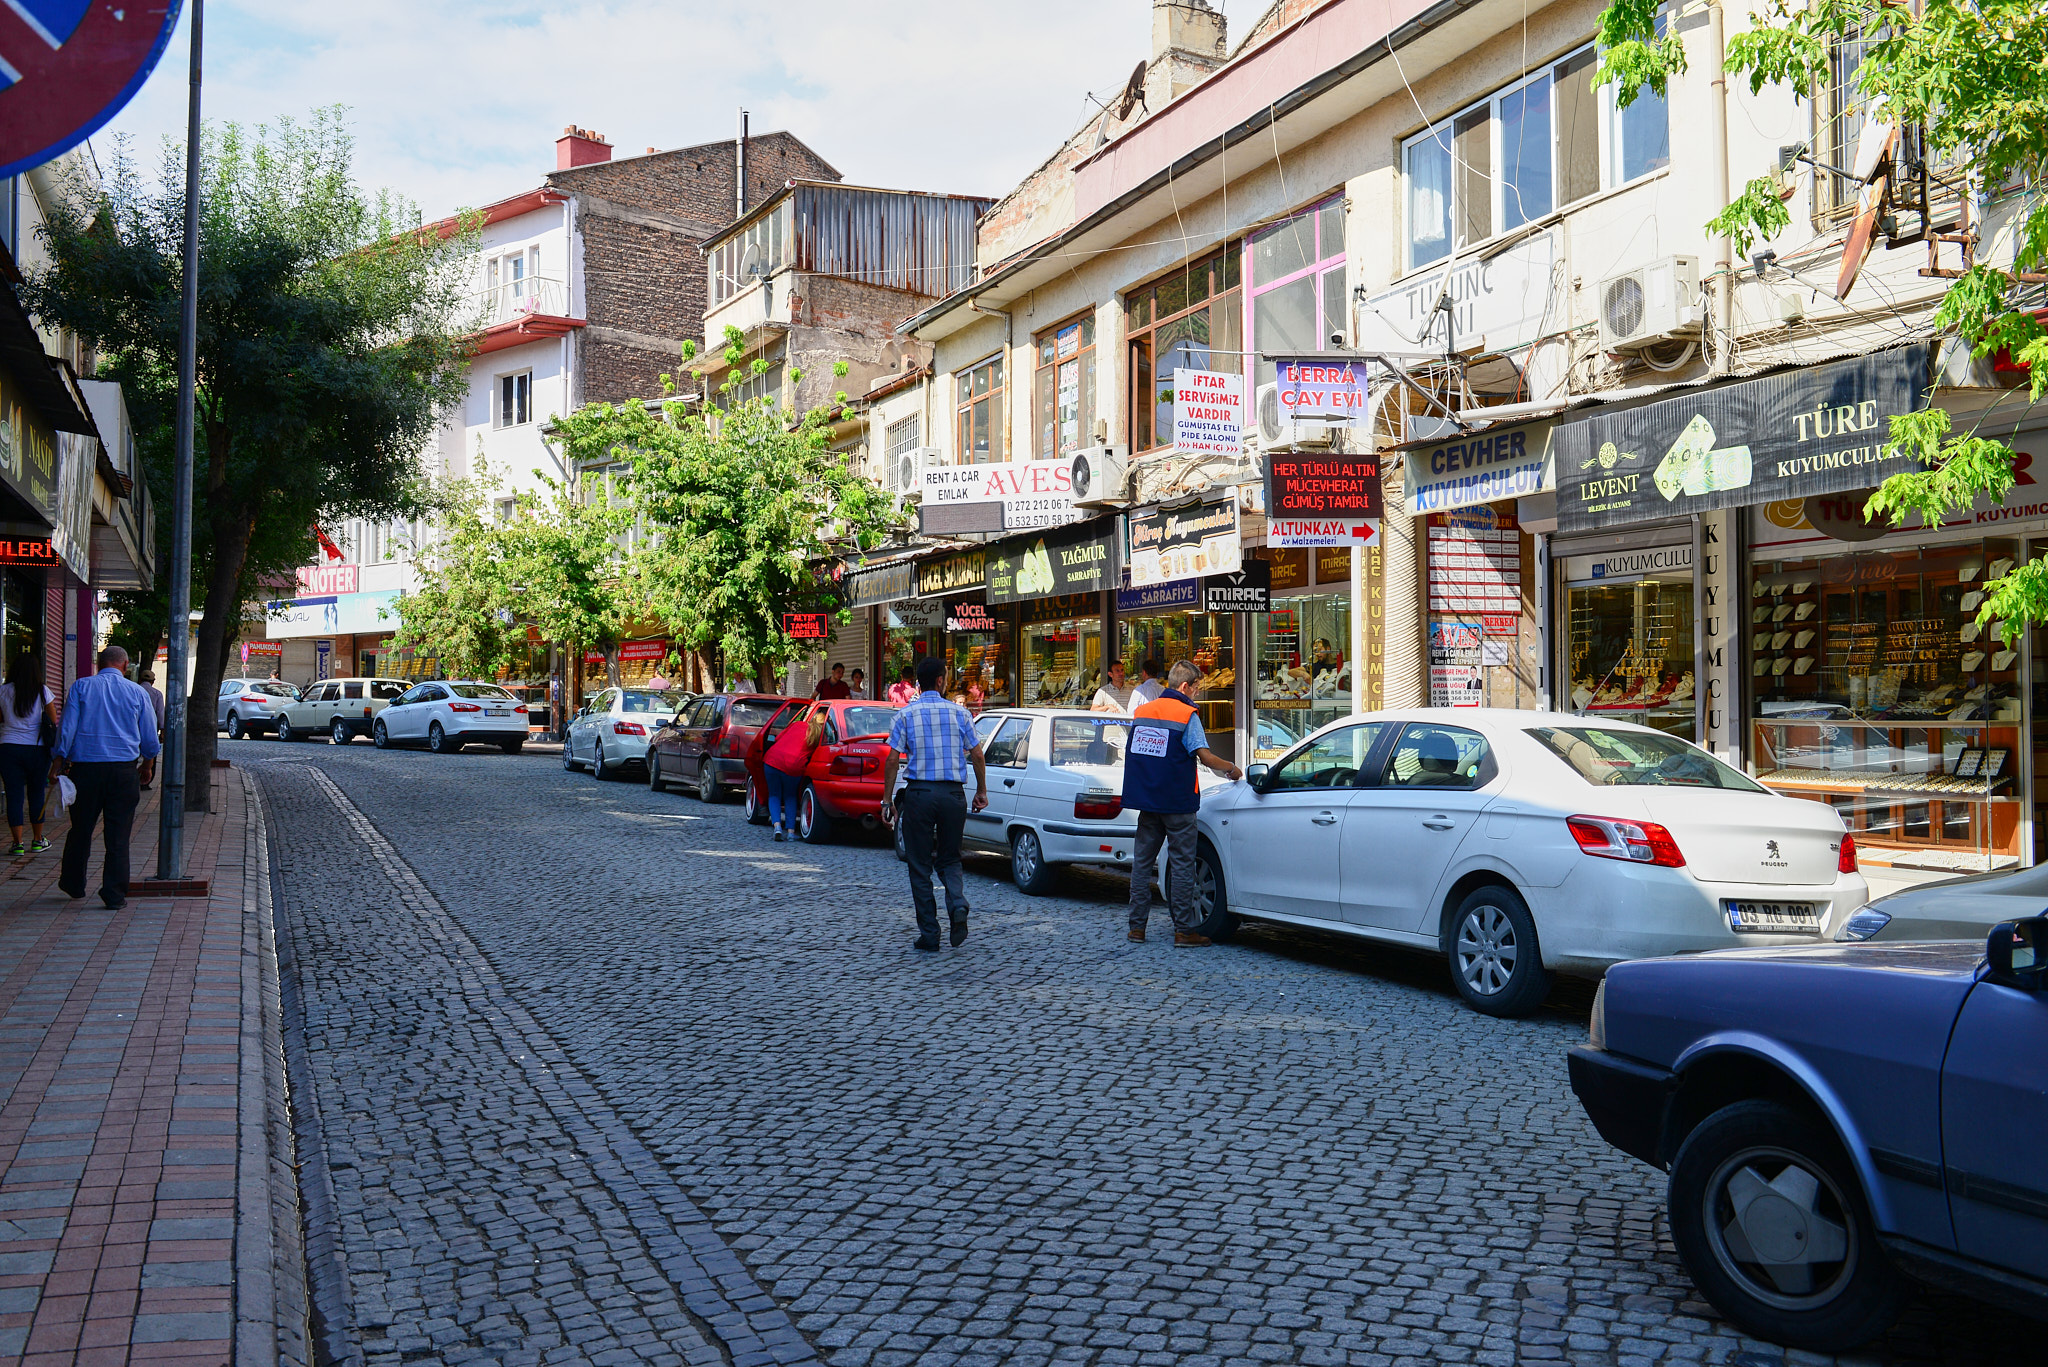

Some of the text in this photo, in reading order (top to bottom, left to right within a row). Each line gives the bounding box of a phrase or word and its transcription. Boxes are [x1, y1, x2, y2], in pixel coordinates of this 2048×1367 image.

[1286, 366, 1356, 384] BERRA
[1281, 389, 1363, 409] ÇAY EVİ
[1187, 407, 1231, 421] VARDIR
[1793, 400, 1879, 443] TÜRE
[1223, 424, 1240, 432] ETLİ
[1203, 433, 1236, 442] SALONU
[28, 423, 53, 480] NASİP
[1192, 442, 1211, 450] HAN
[1431, 430, 1526, 475] CEVHER
[926, 470, 979, 484] RENT A CAR
[1274, 461, 1375, 477] HER TÜRLÜ ALTIN
[984, 464, 1071, 496] AVES
[1286, 477, 1364, 493] MÜCEVHERAT
[1416, 461, 1543, 511] KUYUMCULUK
[1581, 473, 1640, 501] LEVENT
[938, 488, 968, 501] EMLAK
[1283, 494, 1369, 511] GÜMÜŞ TAMİRİ
[1008, 503, 1012, 512] 0
[1015, 501, 1031, 511] 272
[1033, 499, 1049, 510] 212
[1051, 499, 1062, 509] 06
[1008, 514, 1075, 526] 0 532 570 58 37
[1271, 521, 1346, 537] ALTUNKAYA
[1291, 536, 1337, 545] Malzemeleri
[1060, 544, 1107, 566] YAĞMUR
[919, 560, 944, 593] YÜCEL
[992, 576, 1011, 588] LEVENT
[1067, 568, 1102, 582] SARRAFİYE
[1141, 586, 1194, 605] SARRAFİYE
[955, 602, 987, 617] YÜCEL
[1208, 602, 1266, 611] KUYUMCULUK
[946, 617, 996, 631] SARRAFİYE
[1485, 617, 1515, 628] BERBER
[1435, 625, 1478, 648] AVES
[1738, 904, 1759, 923] 03
[1763, 905, 1783, 923] RG
[1788, 906, 1813, 924] 001
